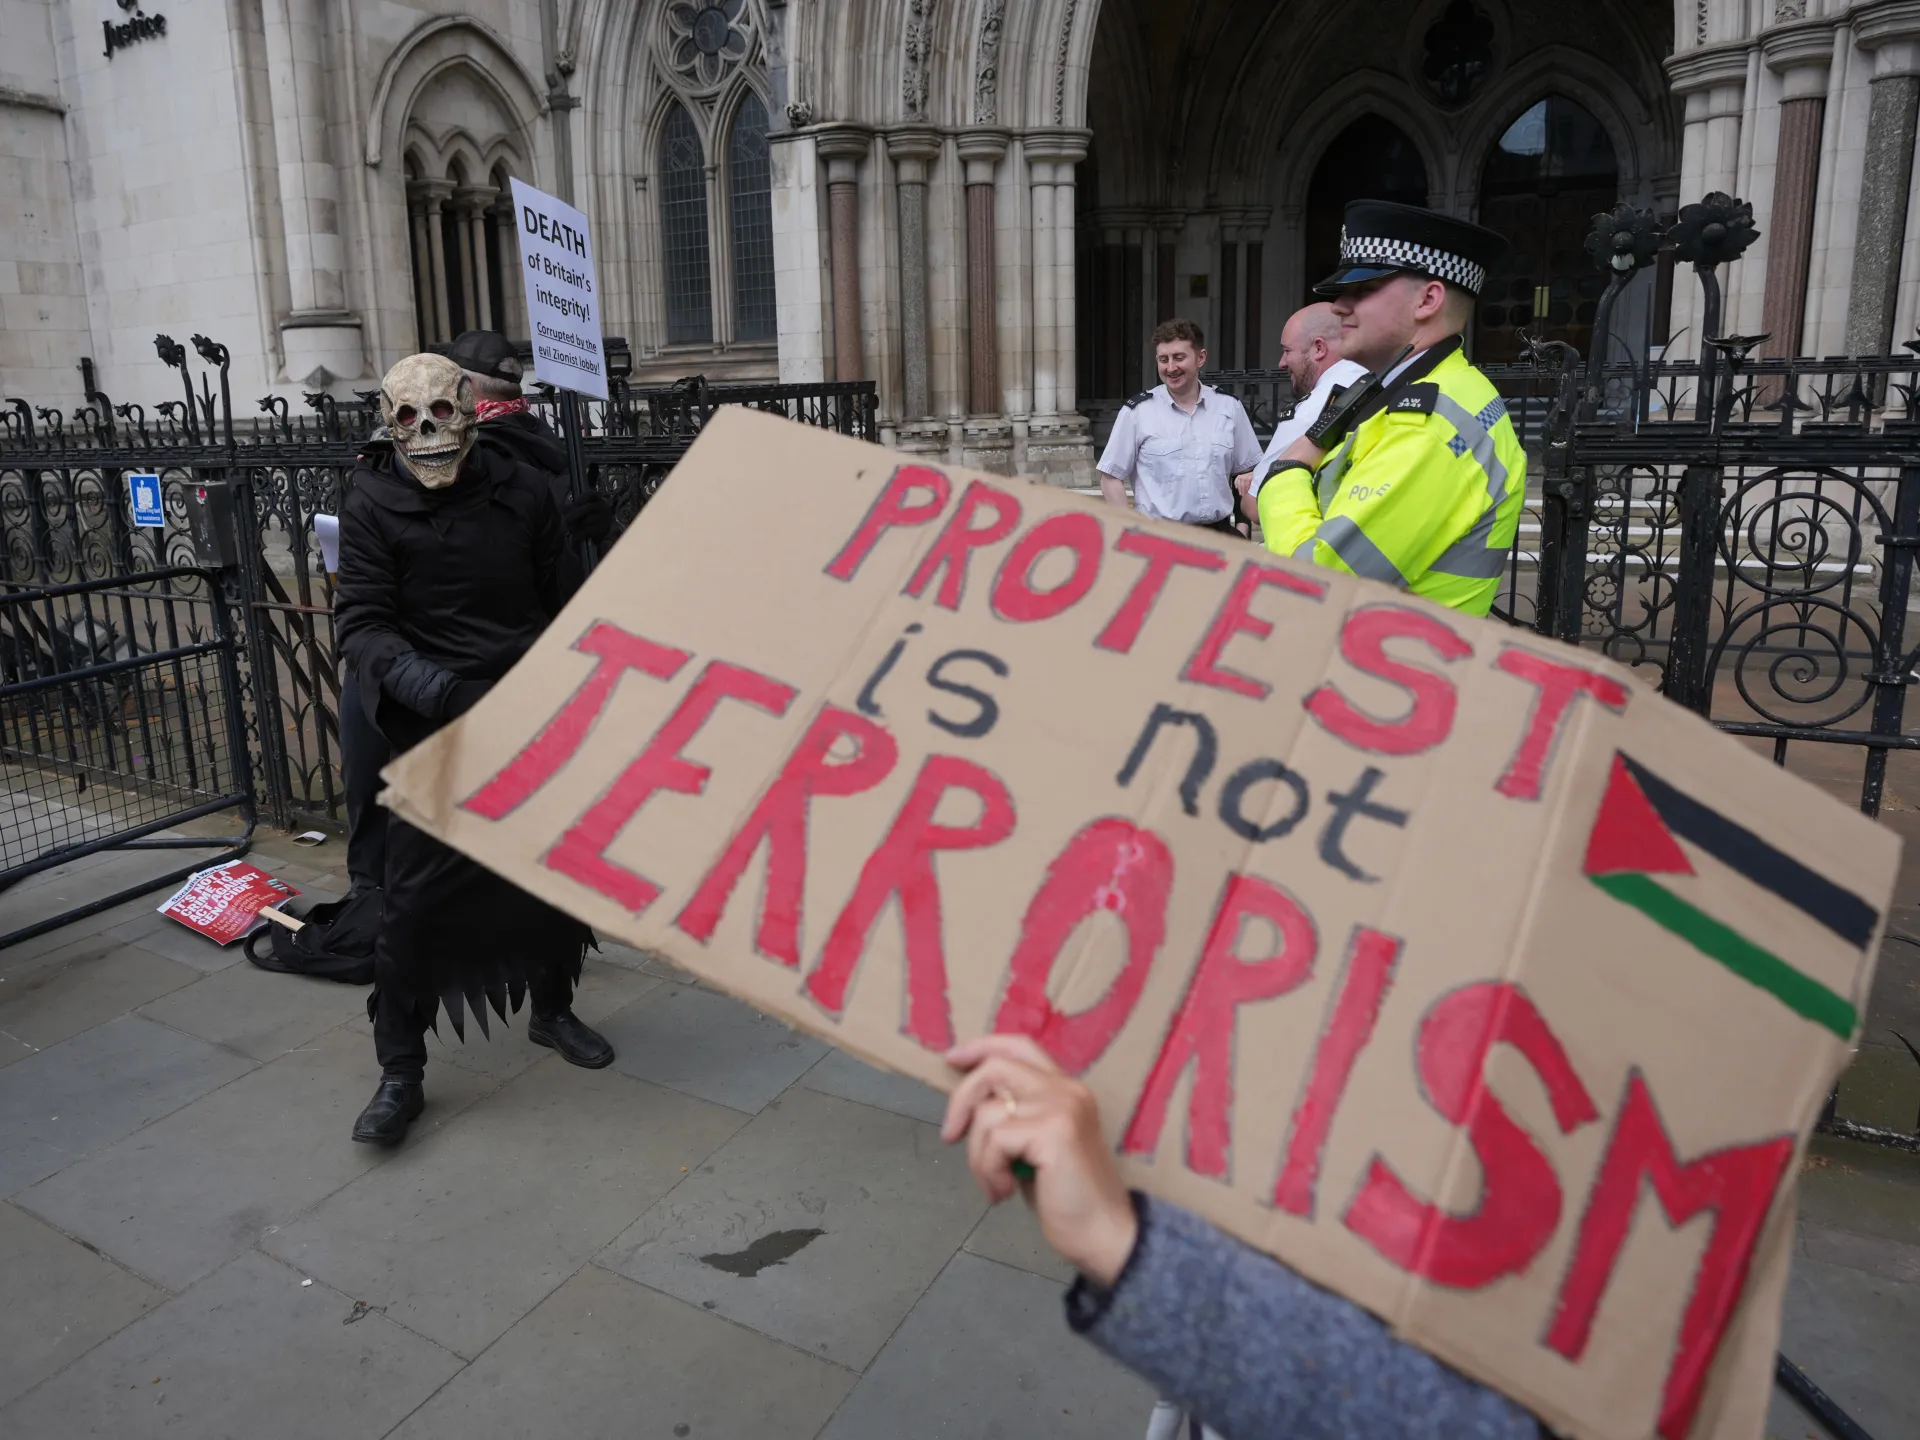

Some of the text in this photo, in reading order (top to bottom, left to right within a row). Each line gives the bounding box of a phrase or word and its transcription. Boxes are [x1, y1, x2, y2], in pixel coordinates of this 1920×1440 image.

[102, 10, 166, 60] Justice
[523, 205, 587, 259] DEATH
[528, 252, 592, 293] of Britain's
[535, 283, 591, 323] integrity!
[536, 321, 597, 353] Corrupted by the
[538, 345, 600, 374] evil Zionist lobby!
[823, 464, 1634, 801] PROTEST
[856, 622, 1408, 883] is not
[170, 894, 197, 913] IT'S
[193, 873, 219, 894] NOT
[171, 877, 200, 902] Socialist
[180, 875, 234, 917] CRIME TO
[188, 902, 213, 923] ACT
[211, 872, 260, 903] AGAINST
[197, 883, 254, 926] GENOCIDE
[455, 617, 1797, 1440] TERRORISM
